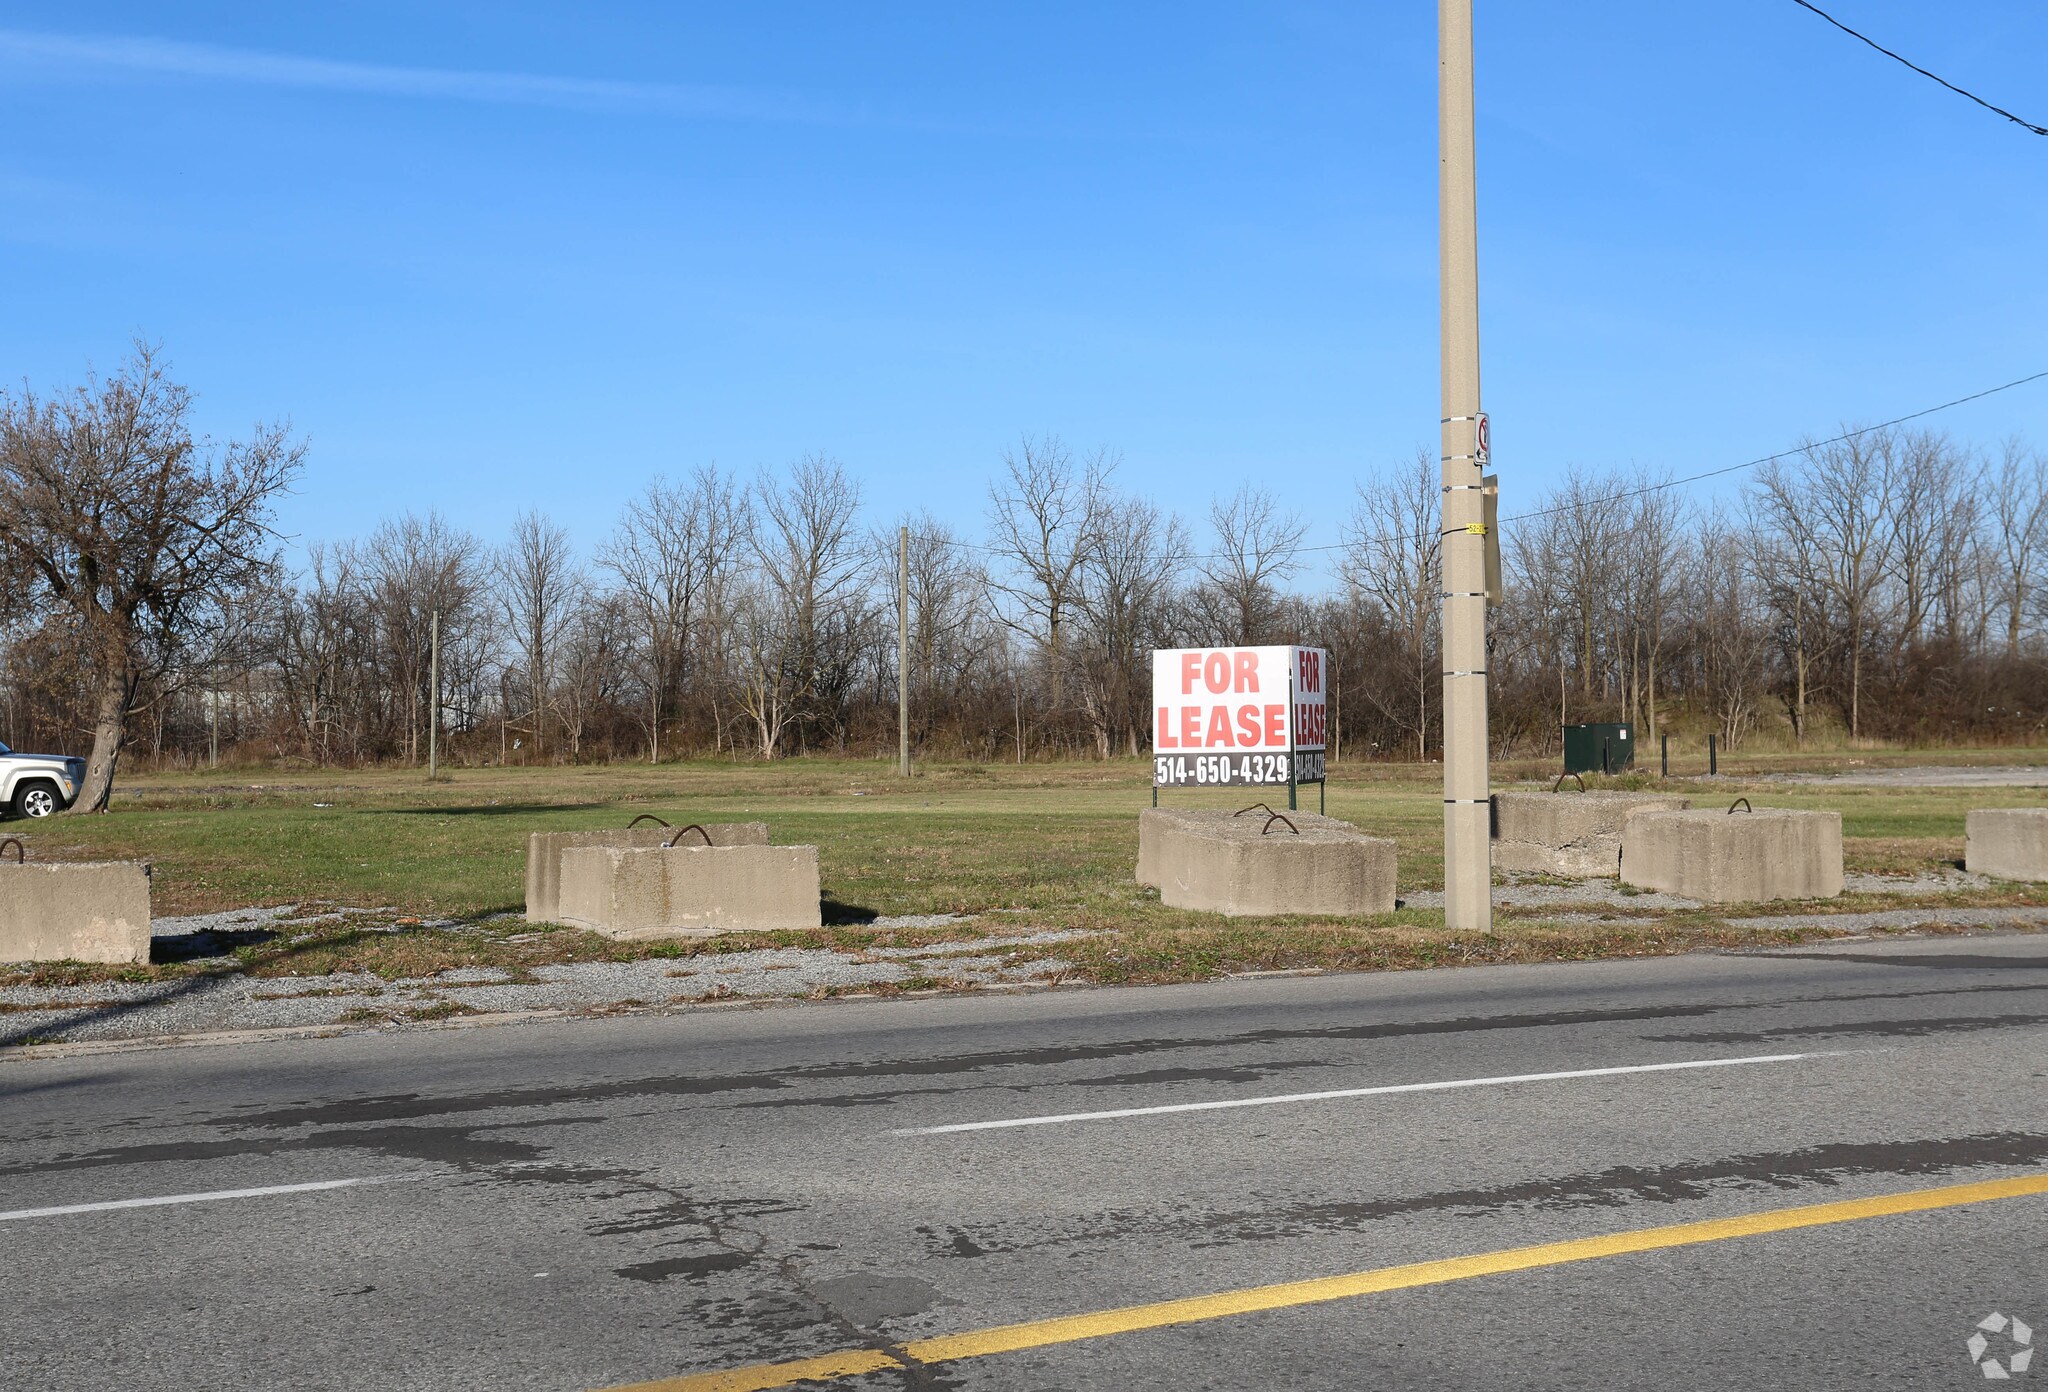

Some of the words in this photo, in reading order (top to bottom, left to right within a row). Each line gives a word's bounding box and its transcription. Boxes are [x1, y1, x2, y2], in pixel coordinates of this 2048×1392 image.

[1181, 651, 1260, 695] FOR
[1299, 650, 1320, 693] FOR
[1158, 704, 1286, 748] LEASE
[1295, 703, 1325, 746] LEASE
[1157, 755, 1288, 784] 514-650-4329
